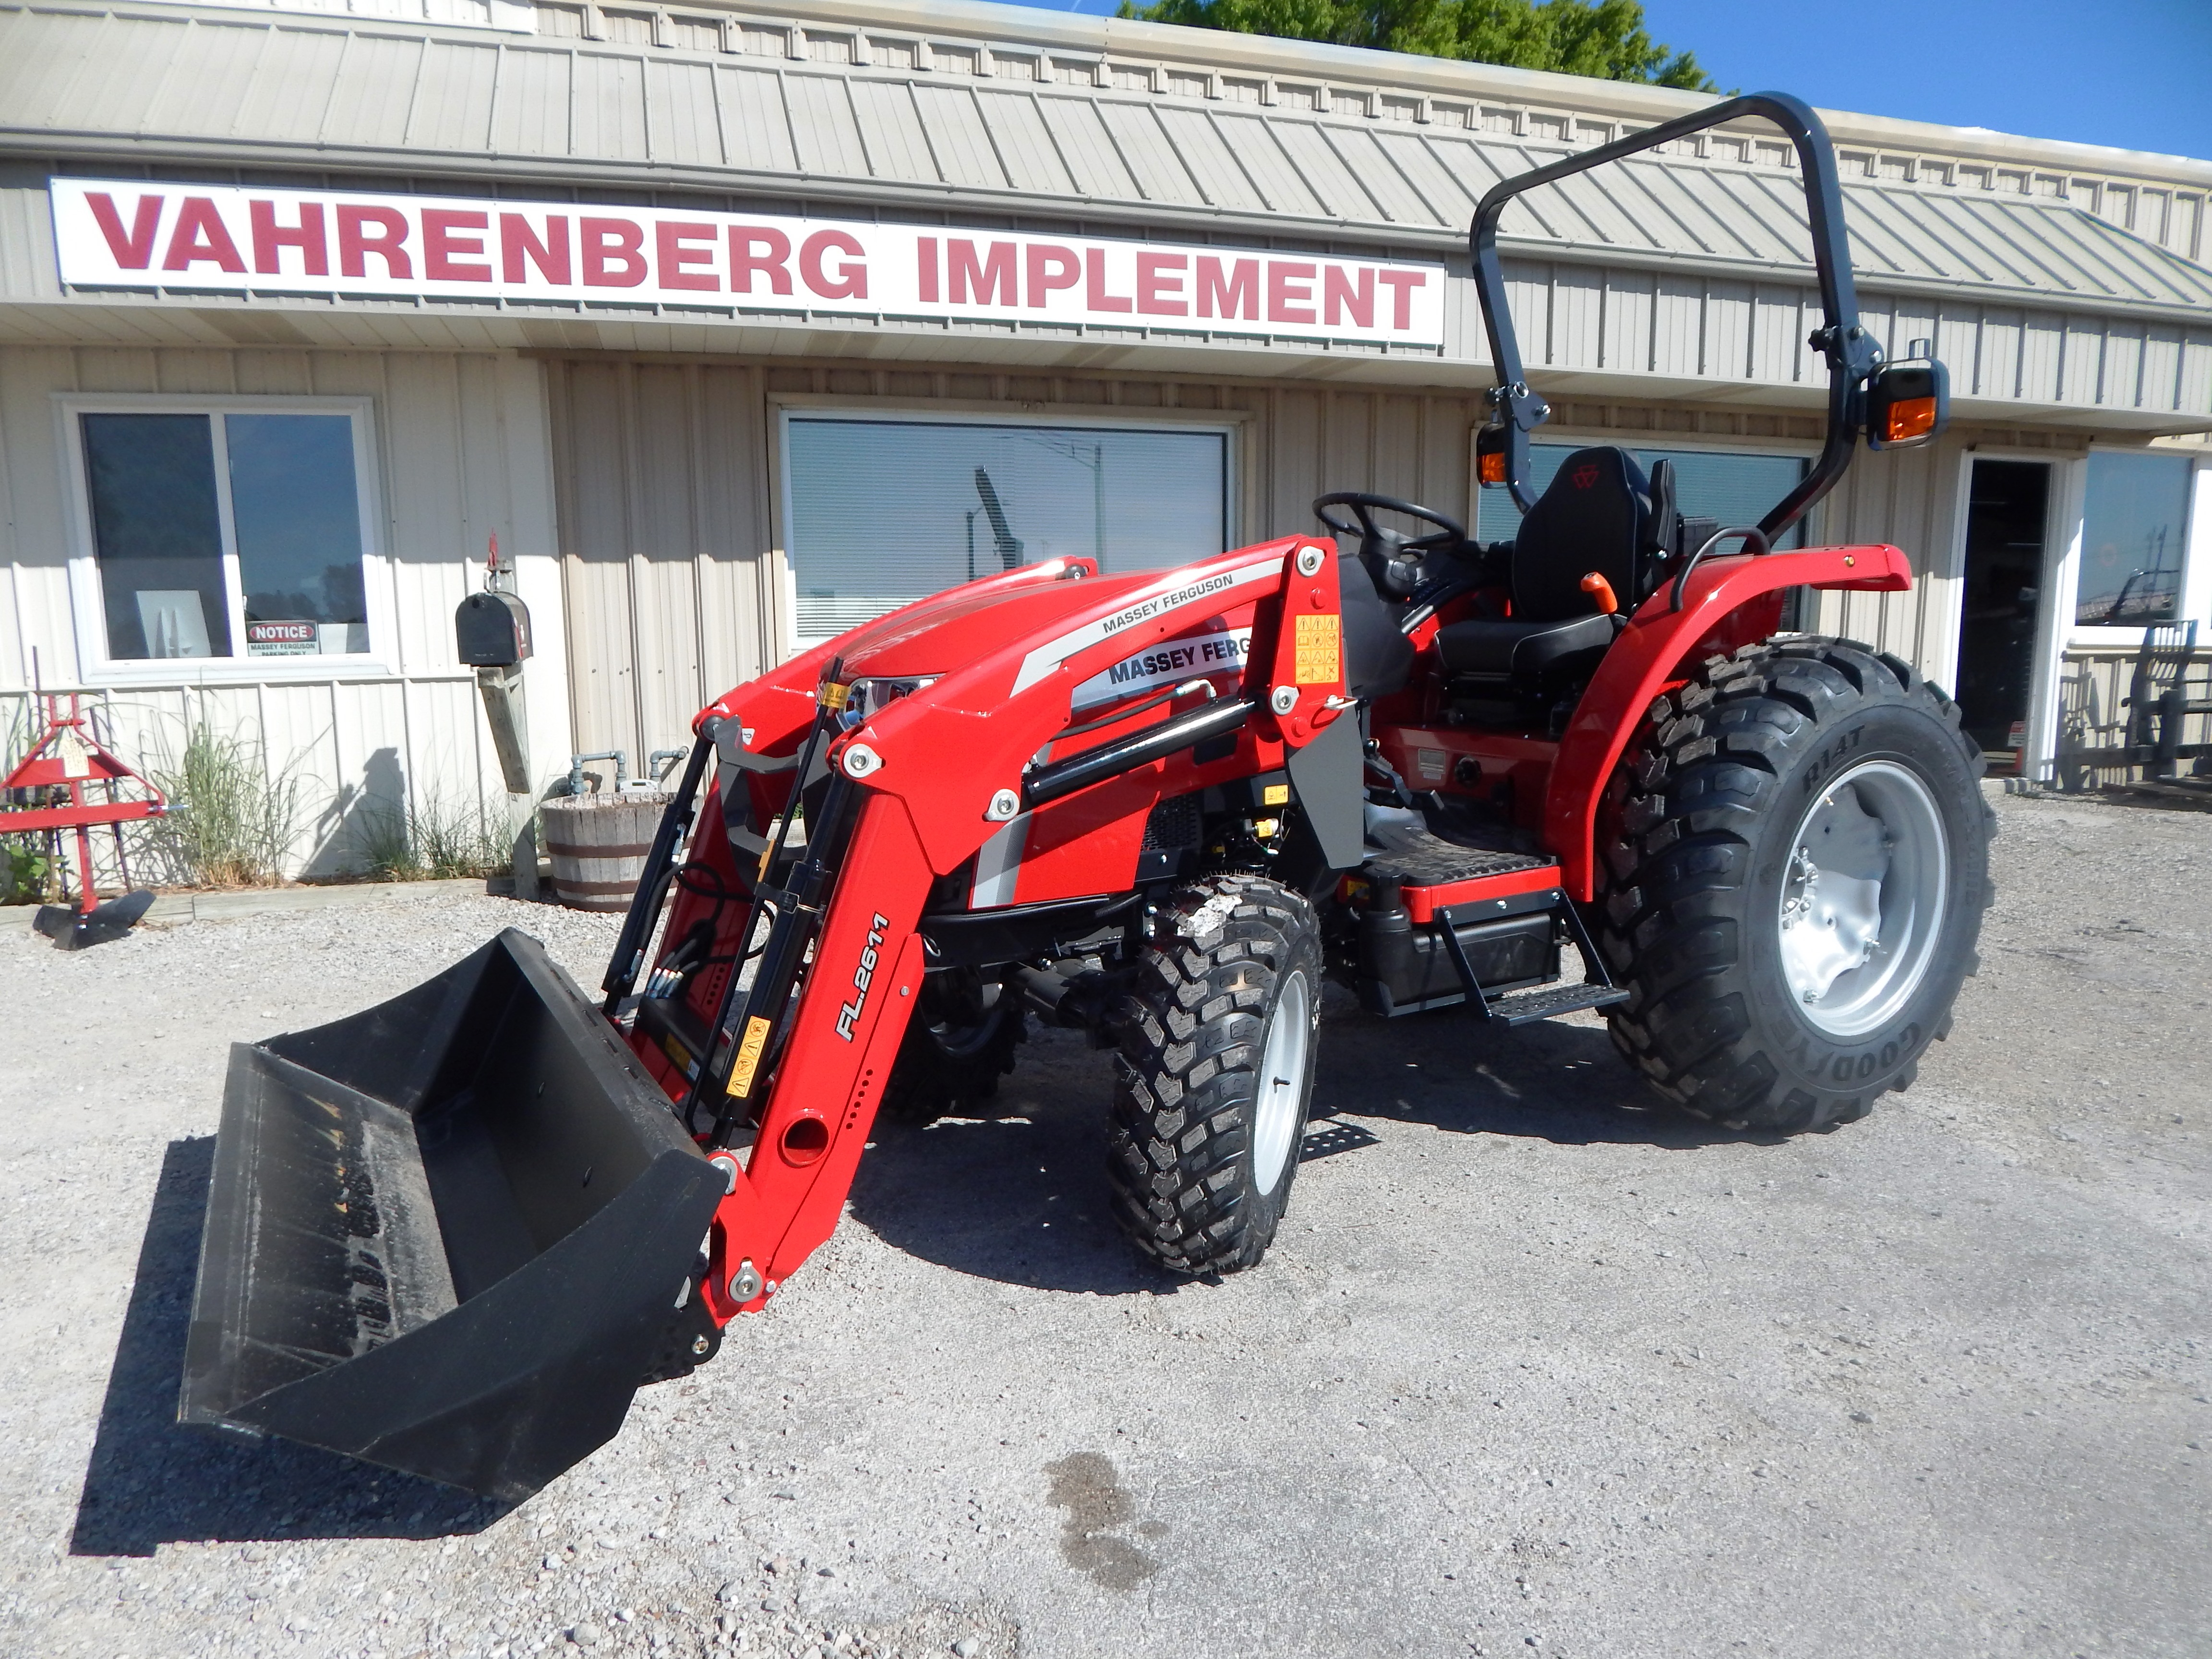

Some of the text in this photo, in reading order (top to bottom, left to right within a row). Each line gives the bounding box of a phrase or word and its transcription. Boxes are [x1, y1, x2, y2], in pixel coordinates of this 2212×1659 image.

[84, 193, 1426, 330] VAHRENBERG IMPLEMENT
[256, 626, 308, 638] NOTICE
[1103, 574, 1233, 633] MASSEY FERGUSON
[1108, 646, 1195, 685] MASSEY
[1802, 725, 1865, 793] R14T
[835, 911, 890, 1043] FL.2611
